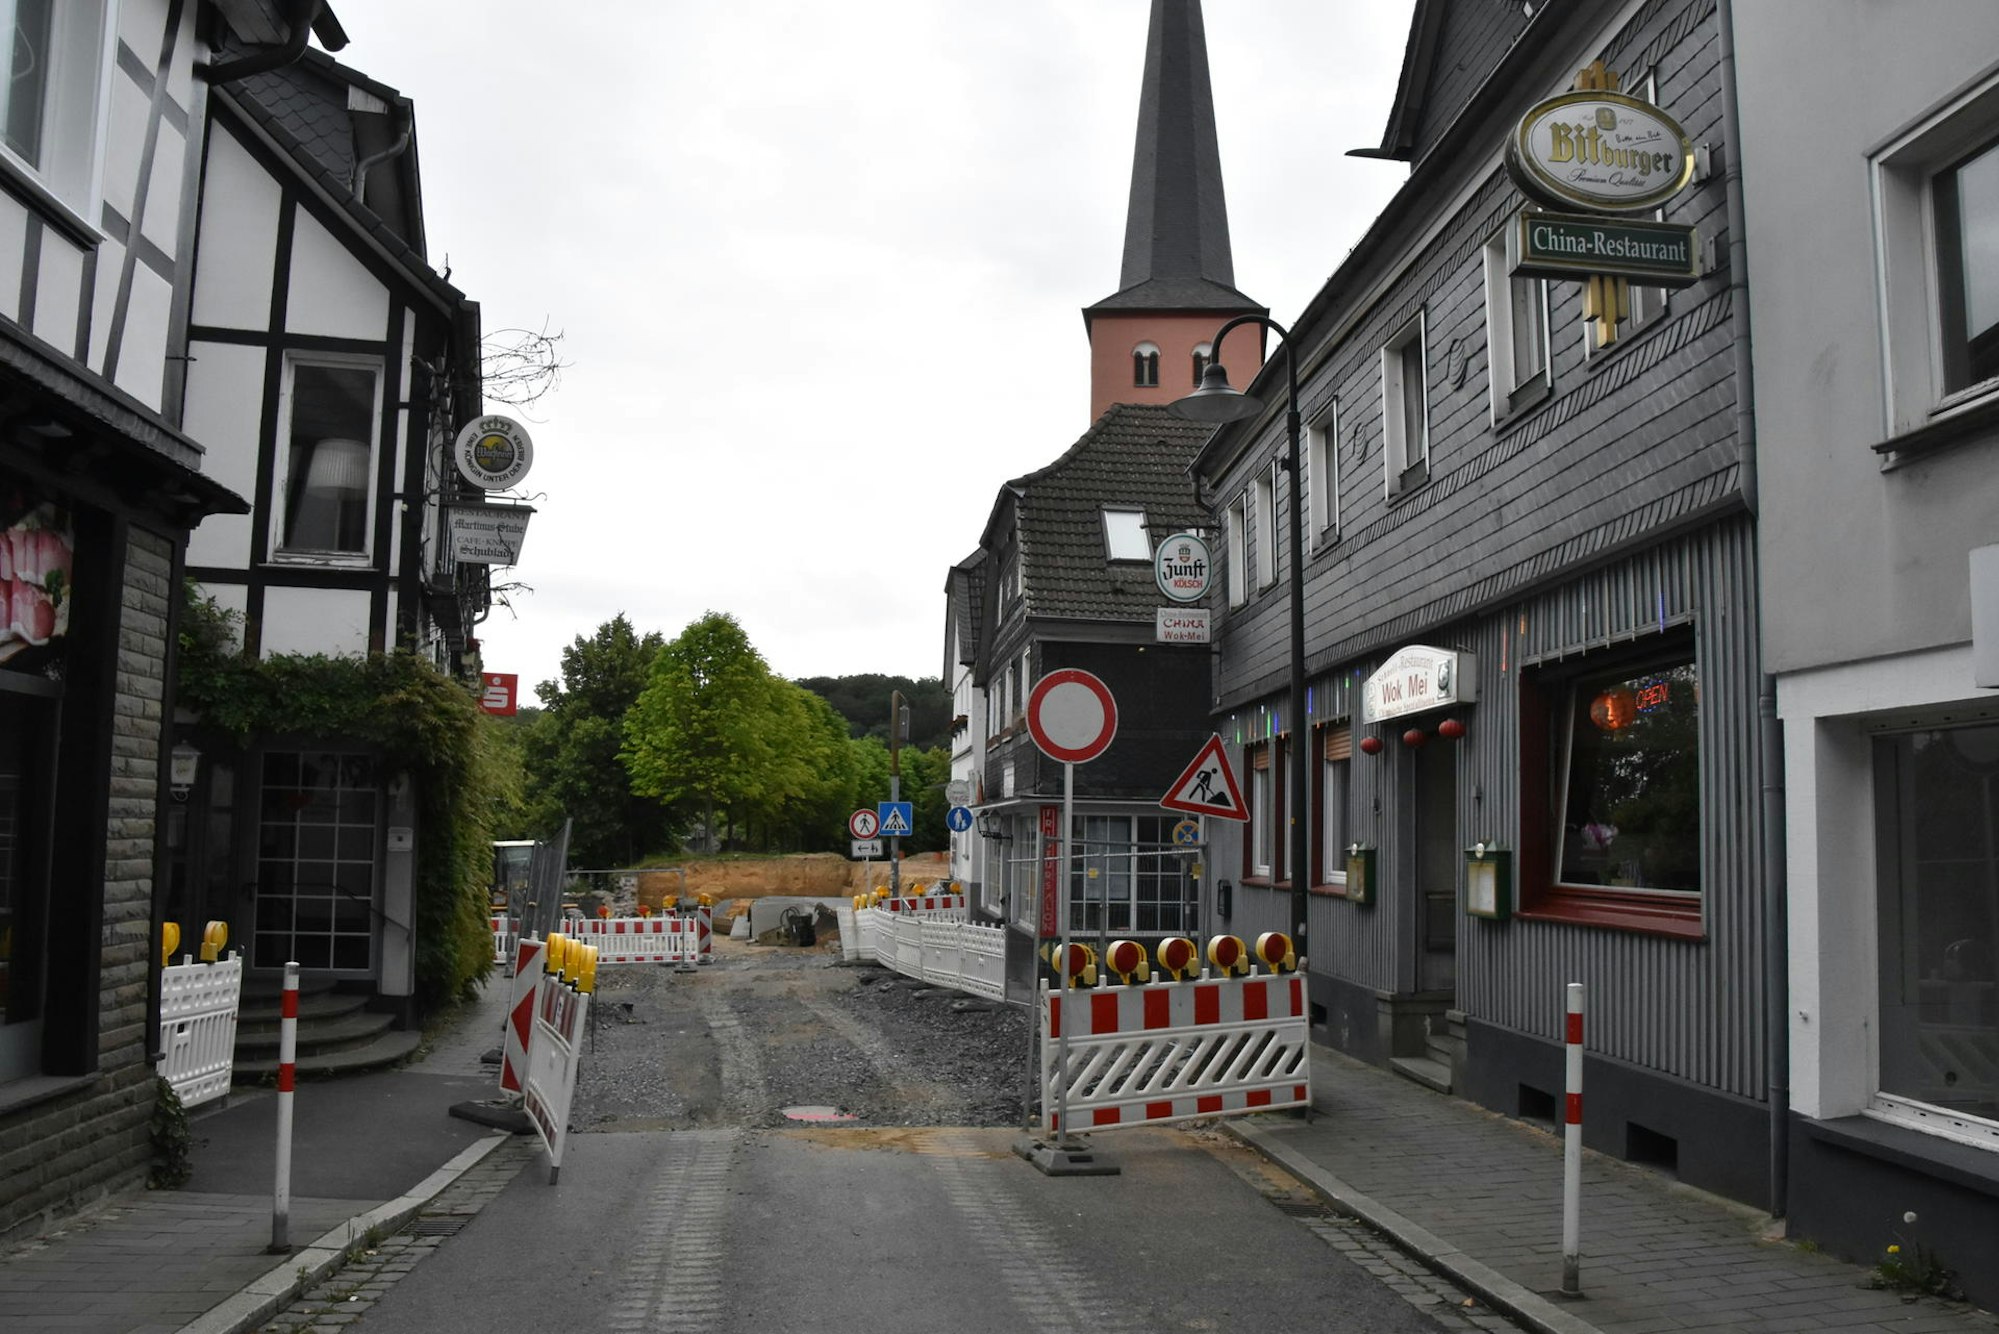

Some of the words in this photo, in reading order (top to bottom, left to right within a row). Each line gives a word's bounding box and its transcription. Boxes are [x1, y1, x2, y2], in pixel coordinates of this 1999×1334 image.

[1548, 122, 1674, 176] Bitburger
[1534, 226, 1686, 262] China-Restaurant
[465, 432, 479, 449] EINE
[512, 434, 525, 462] BIEREN
[464, 450, 483, 478] KÖNIGIN
[508, 461, 522, 477] DEN
[483, 473, 509, 482] UNTER
[1163, 558, 1206, 580] Zunft
[1174, 578, 1202, 588] KÖLSCH
[1163, 618, 1205, 629] CHINA
[1382, 678, 1403, 705] Wok
[1408, 672, 1428, 699] Mei
[1636, 682, 1668, 709] OPEN
